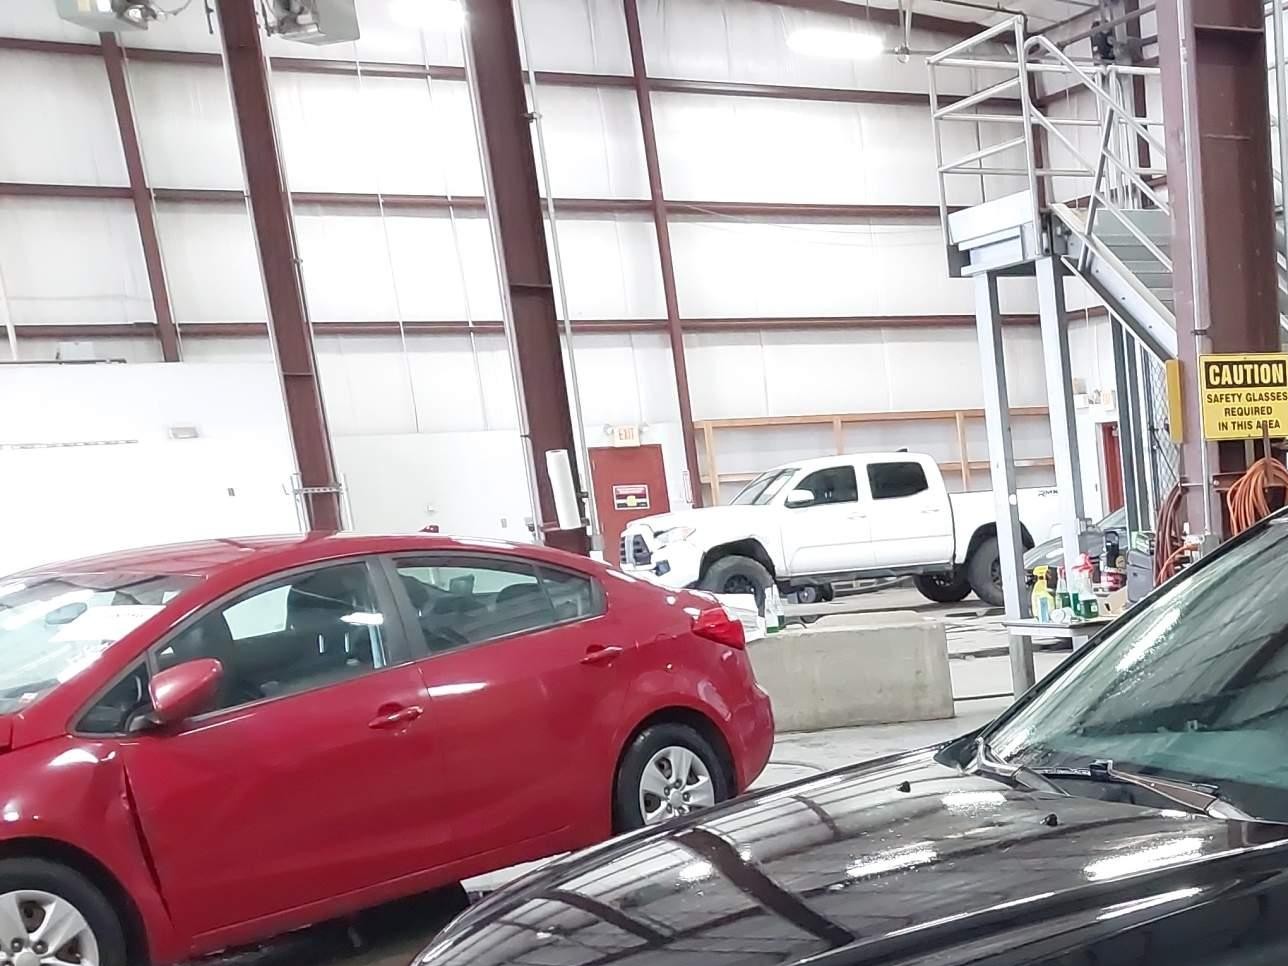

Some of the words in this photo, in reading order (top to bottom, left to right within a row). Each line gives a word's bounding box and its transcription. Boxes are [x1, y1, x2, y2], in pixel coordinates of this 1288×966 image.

[1208, 363, 1284, 386] CAUTION
[1206, 393, 1242, 403] SAFETY
[1245, 391, 1288, 402] GLASSES
[1224, 406, 1273, 417] REQUIRED
[1218, 421, 1228, 431] IN
[1231, 420, 1253, 431] THIS
[618, 427, 634, 441] EXIT
